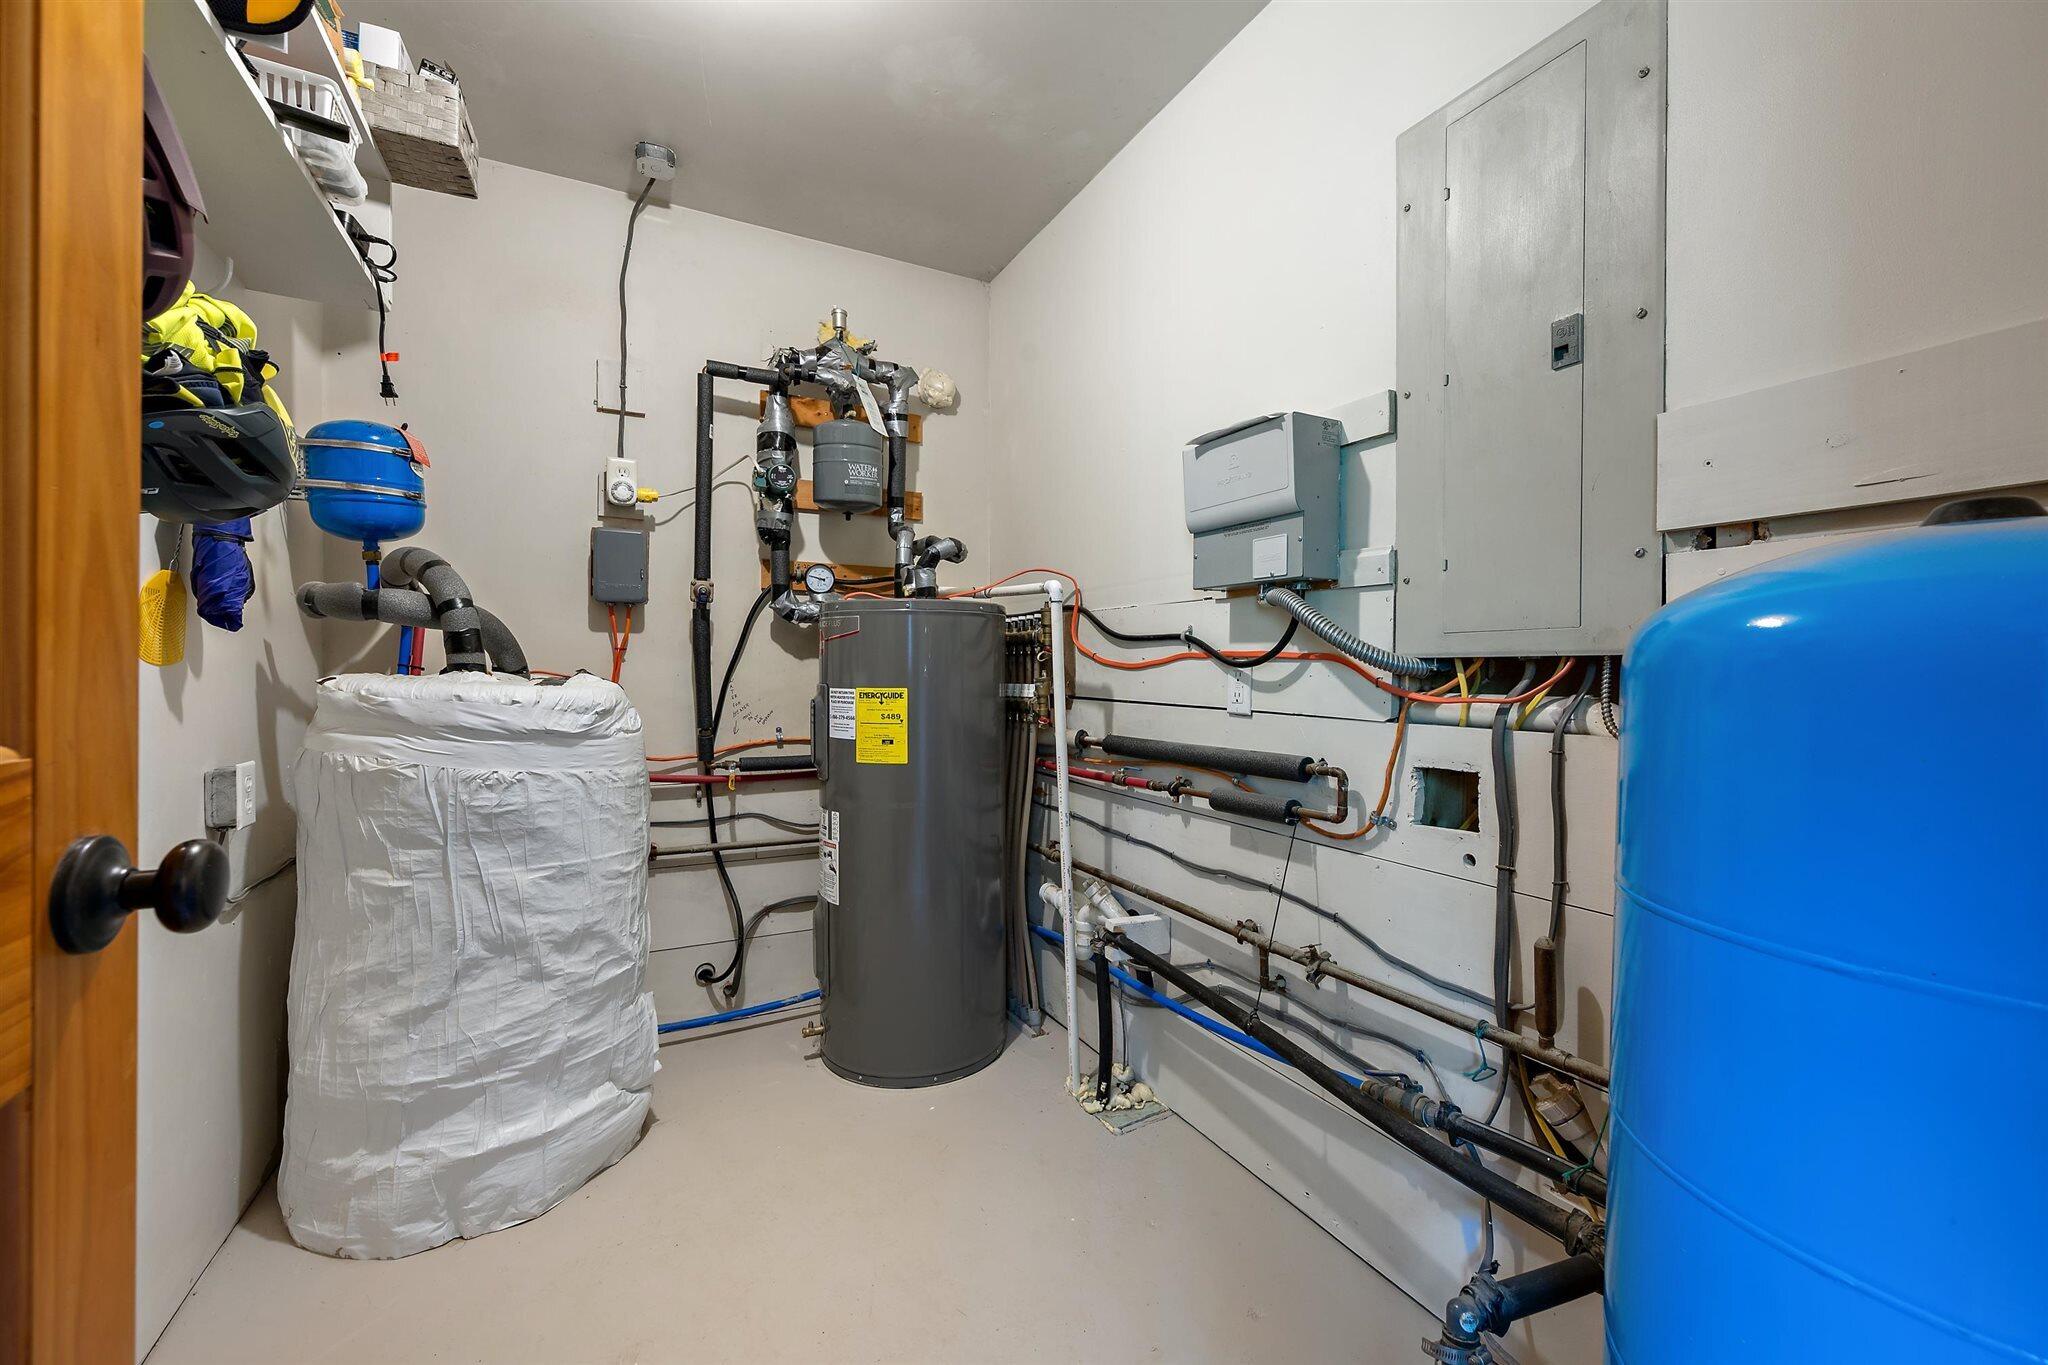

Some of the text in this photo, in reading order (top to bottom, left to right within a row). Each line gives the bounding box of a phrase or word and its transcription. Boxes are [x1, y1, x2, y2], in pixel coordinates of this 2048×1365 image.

[848, 463, 872, 472] WATER
[848, 469, 878, 478] WORKER
[859, 691, 905, 700] ENERGYGUIDE
